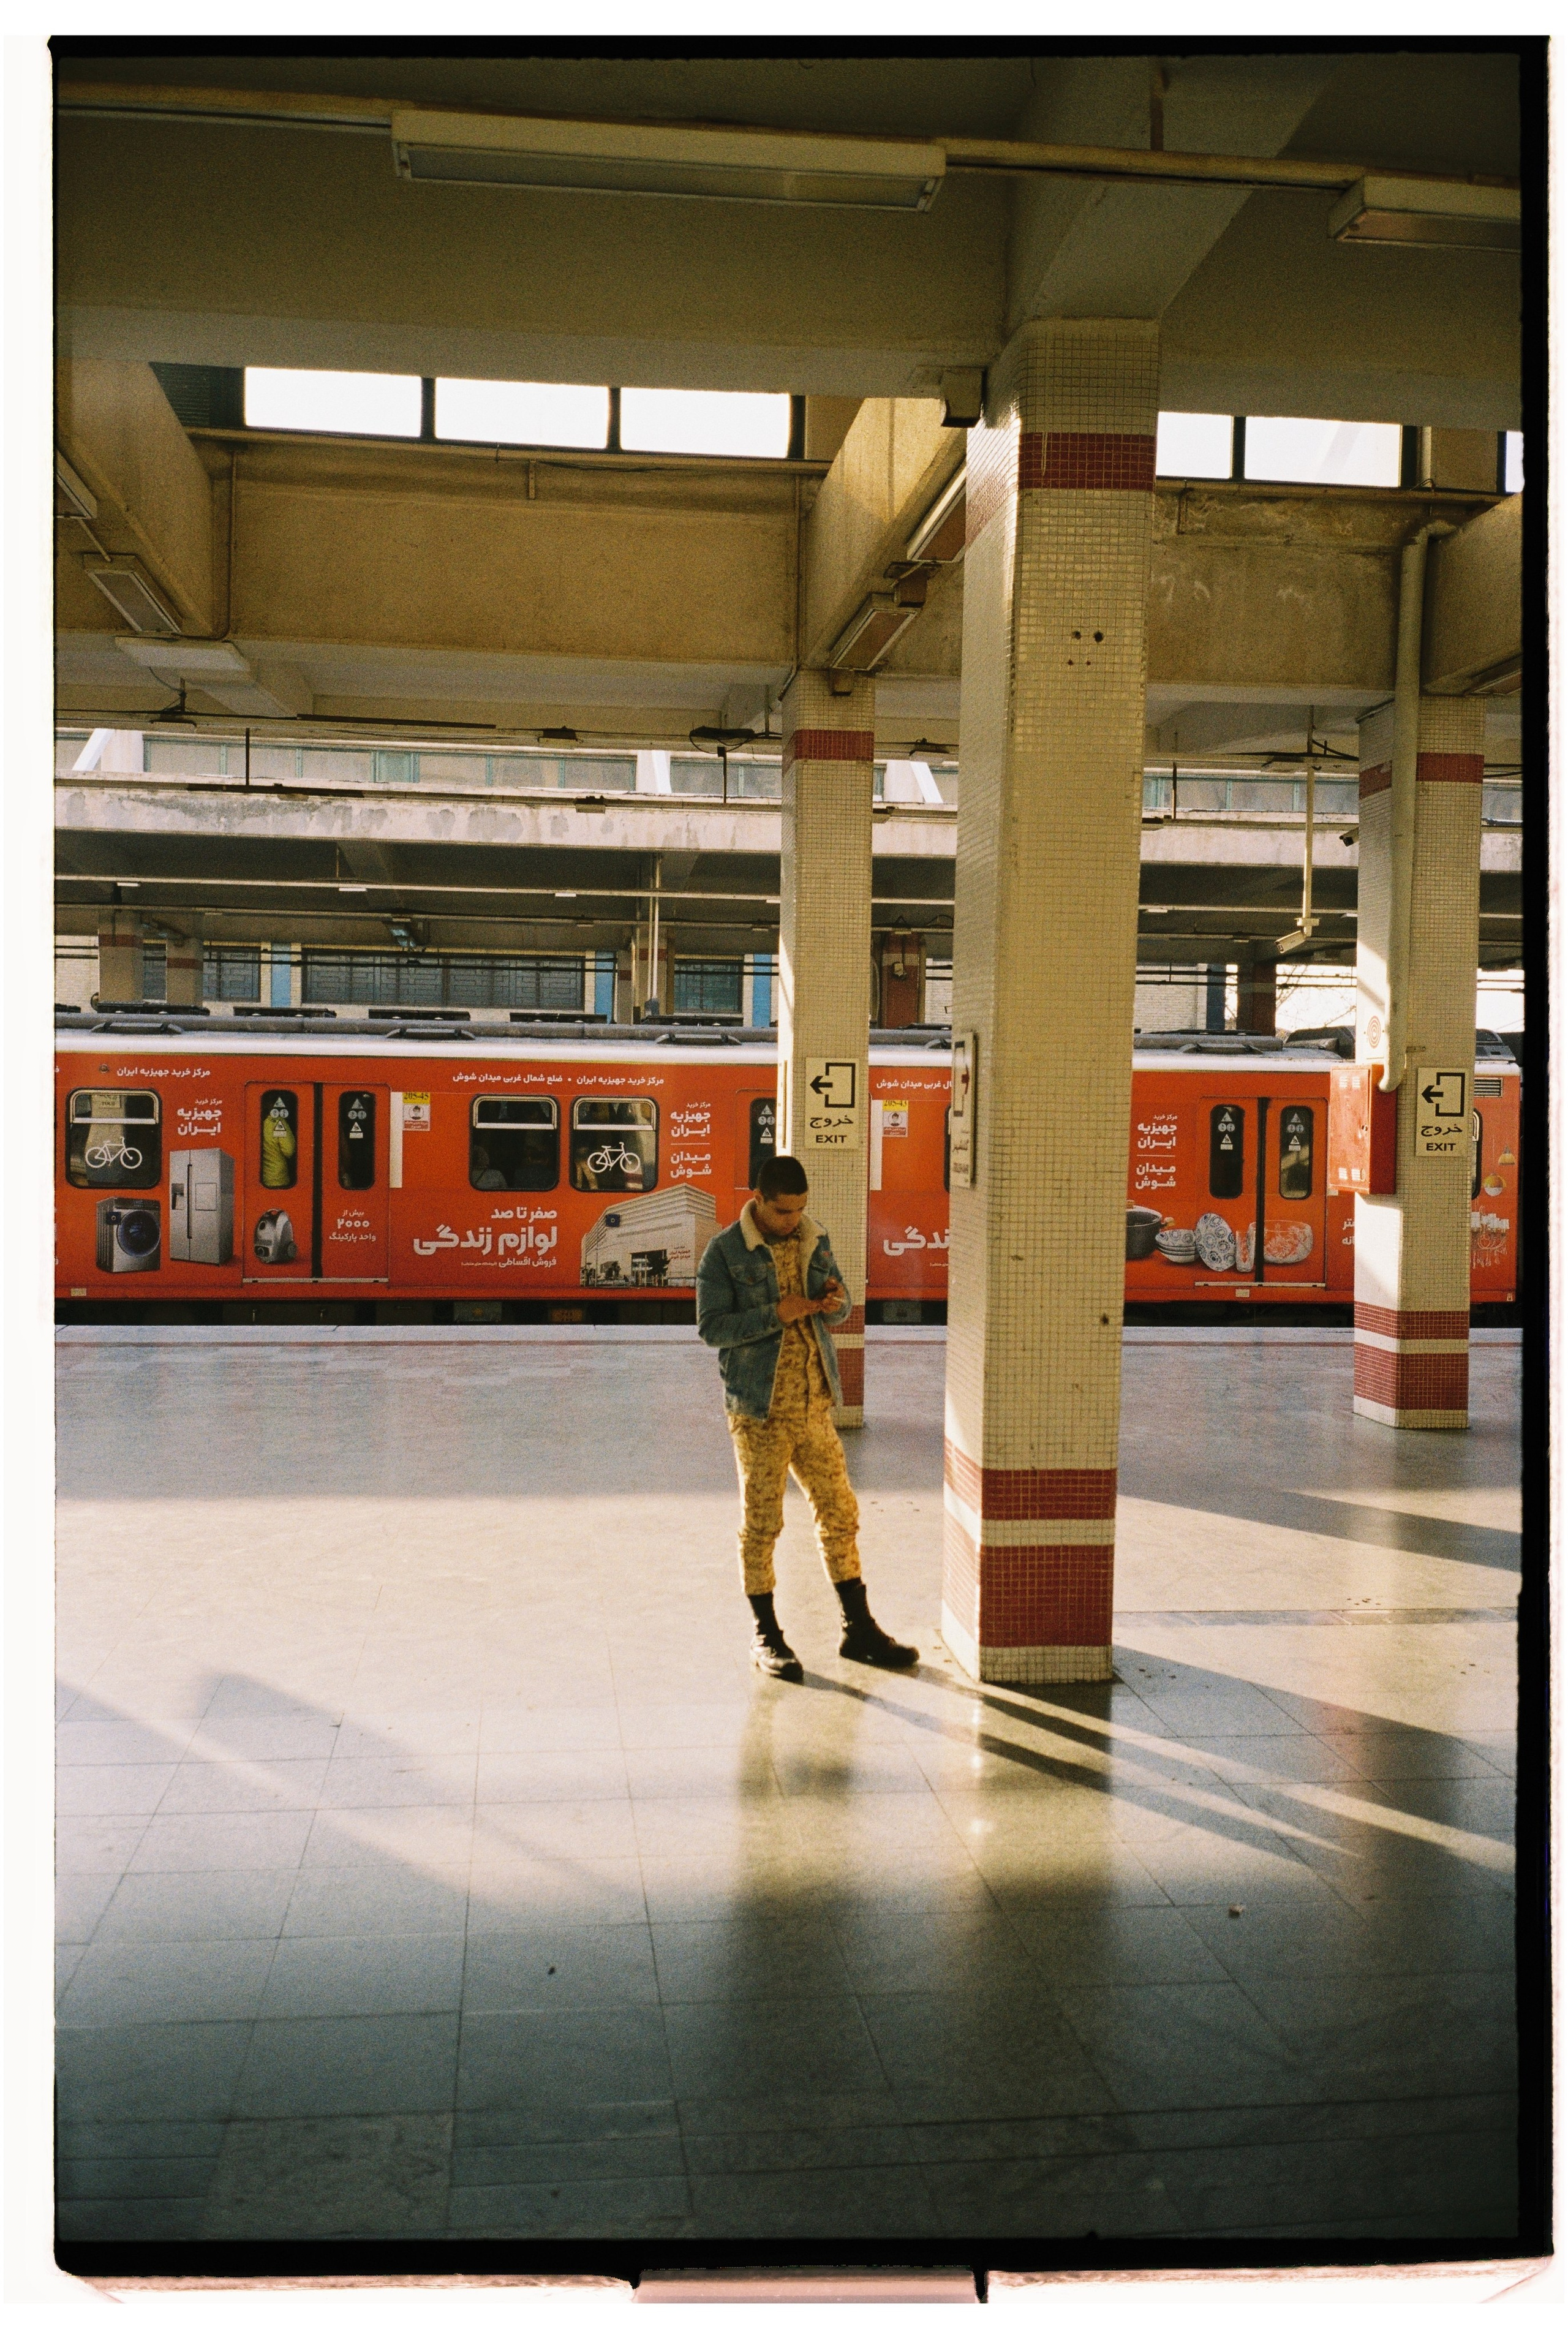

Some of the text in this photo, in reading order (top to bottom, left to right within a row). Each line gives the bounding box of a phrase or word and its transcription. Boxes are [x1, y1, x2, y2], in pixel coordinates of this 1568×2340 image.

[116, 1067, 211, 1078] مرکز خرید جهیزیه ایران
[452, 1072, 563, 1085] ضلع شمال غربی میدان شوش
[576, 1075, 664, 1086] مرکز خرید جهیزیه ایران
[876, 1079, 899, 1089] شوش
[900, 1080, 922, 1089] میدان
[924, 1081, 941, 1089] غربی
[177, 1107, 222, 1121] جهیزیه
[670, 1111, 711, 1123] جهیزیه
[810, 1115, 854, 1128] خروج
[178, 1122, 221, 1136] ایران
[671, 1124, 710, 1138] ایران
[1137, 1122, 1177, 1134] جهیزیه
[1421, 1123, 1463, 1137] خروج
[815, 1134, 847, 1143] EXIT
[1137, 1136, 1177, 1149] ایران
[1426, 1142, 1457, 1151] EXIT
[670, 1152, 711, 1164] میدان
[670, 1164, 712, 1178] شوش
[1136, 1163, 1176, 1175] میدان
[1135, 1176, 1177, 1190] شوش
[491, 1206, 557, 1223] صفر تا صد
[329, 1232, 357, 1242] پارکینگ
[413, 1224, 557, 1256] لوازم زندگی
[883, 1226, 950, 1256] ندگی
[498, 1256, 531, 1268] اقساطی
[532, 1256, 557, 1268] فروش
